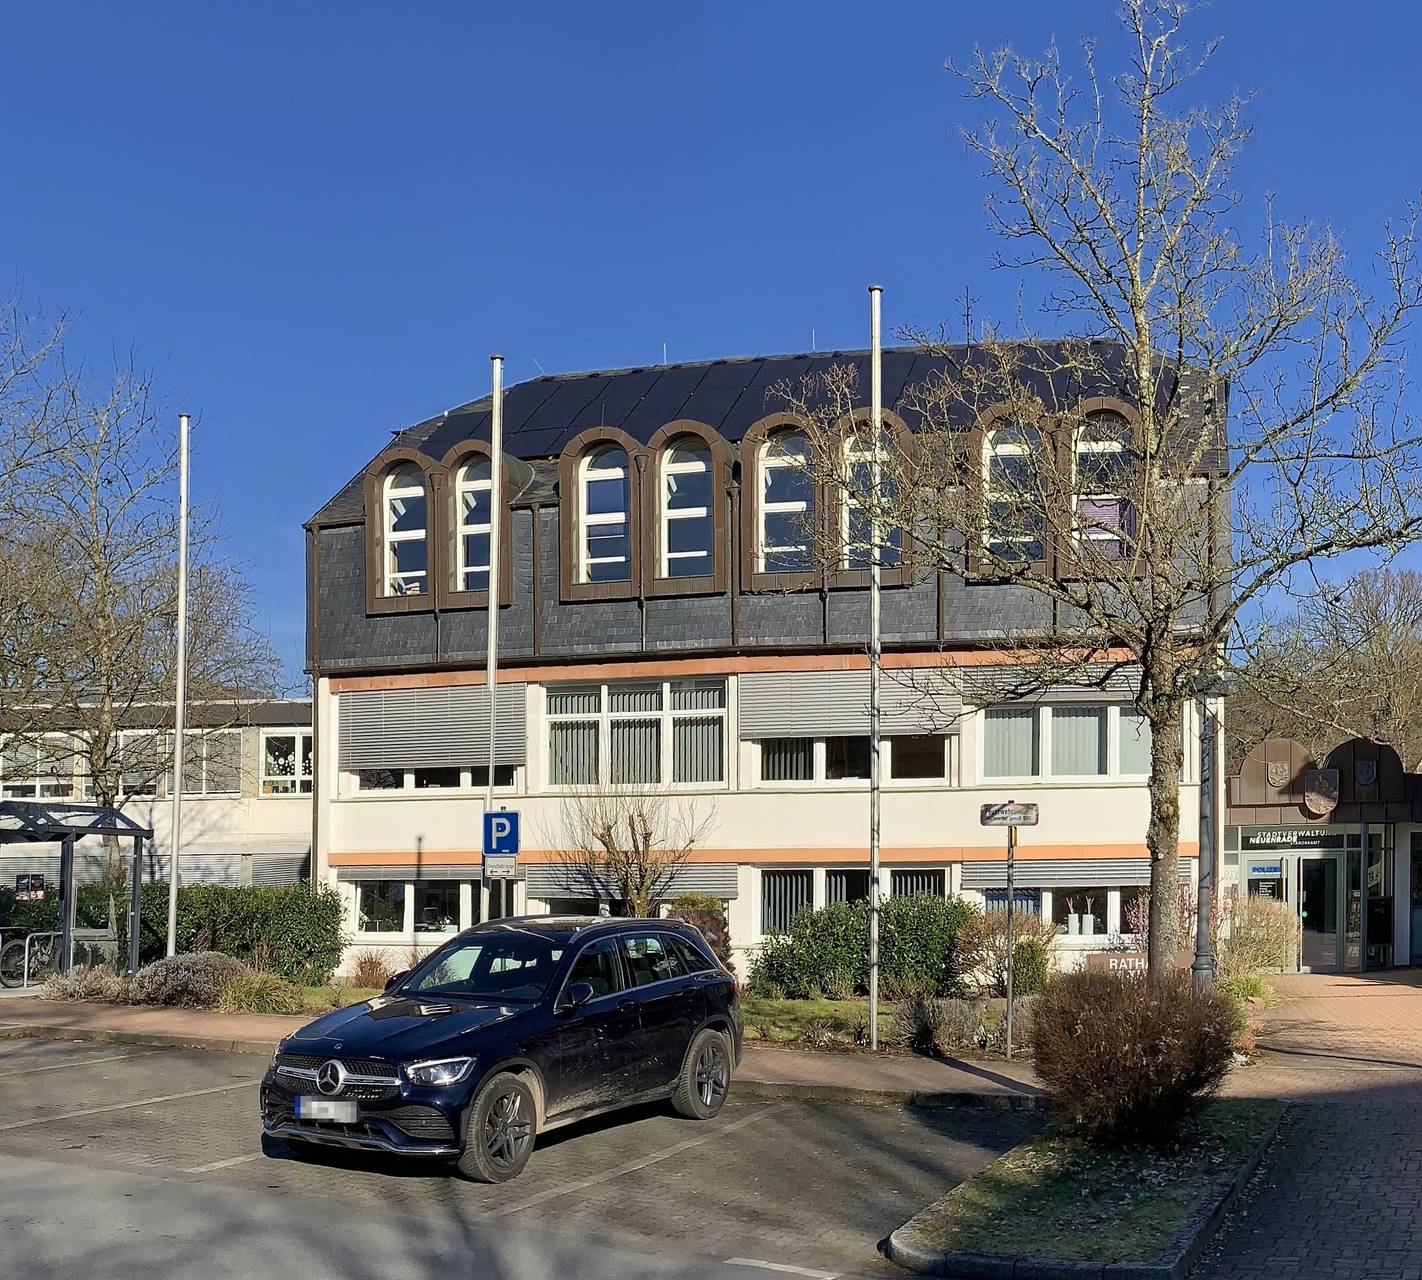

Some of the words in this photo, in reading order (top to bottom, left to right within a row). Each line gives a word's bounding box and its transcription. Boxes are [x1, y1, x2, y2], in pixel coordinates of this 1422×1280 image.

[491, 817, 511, 849] P
[1249, 836, 1298, 844] NEUENRADE
[1109, 957, 1149, 970] RATH
